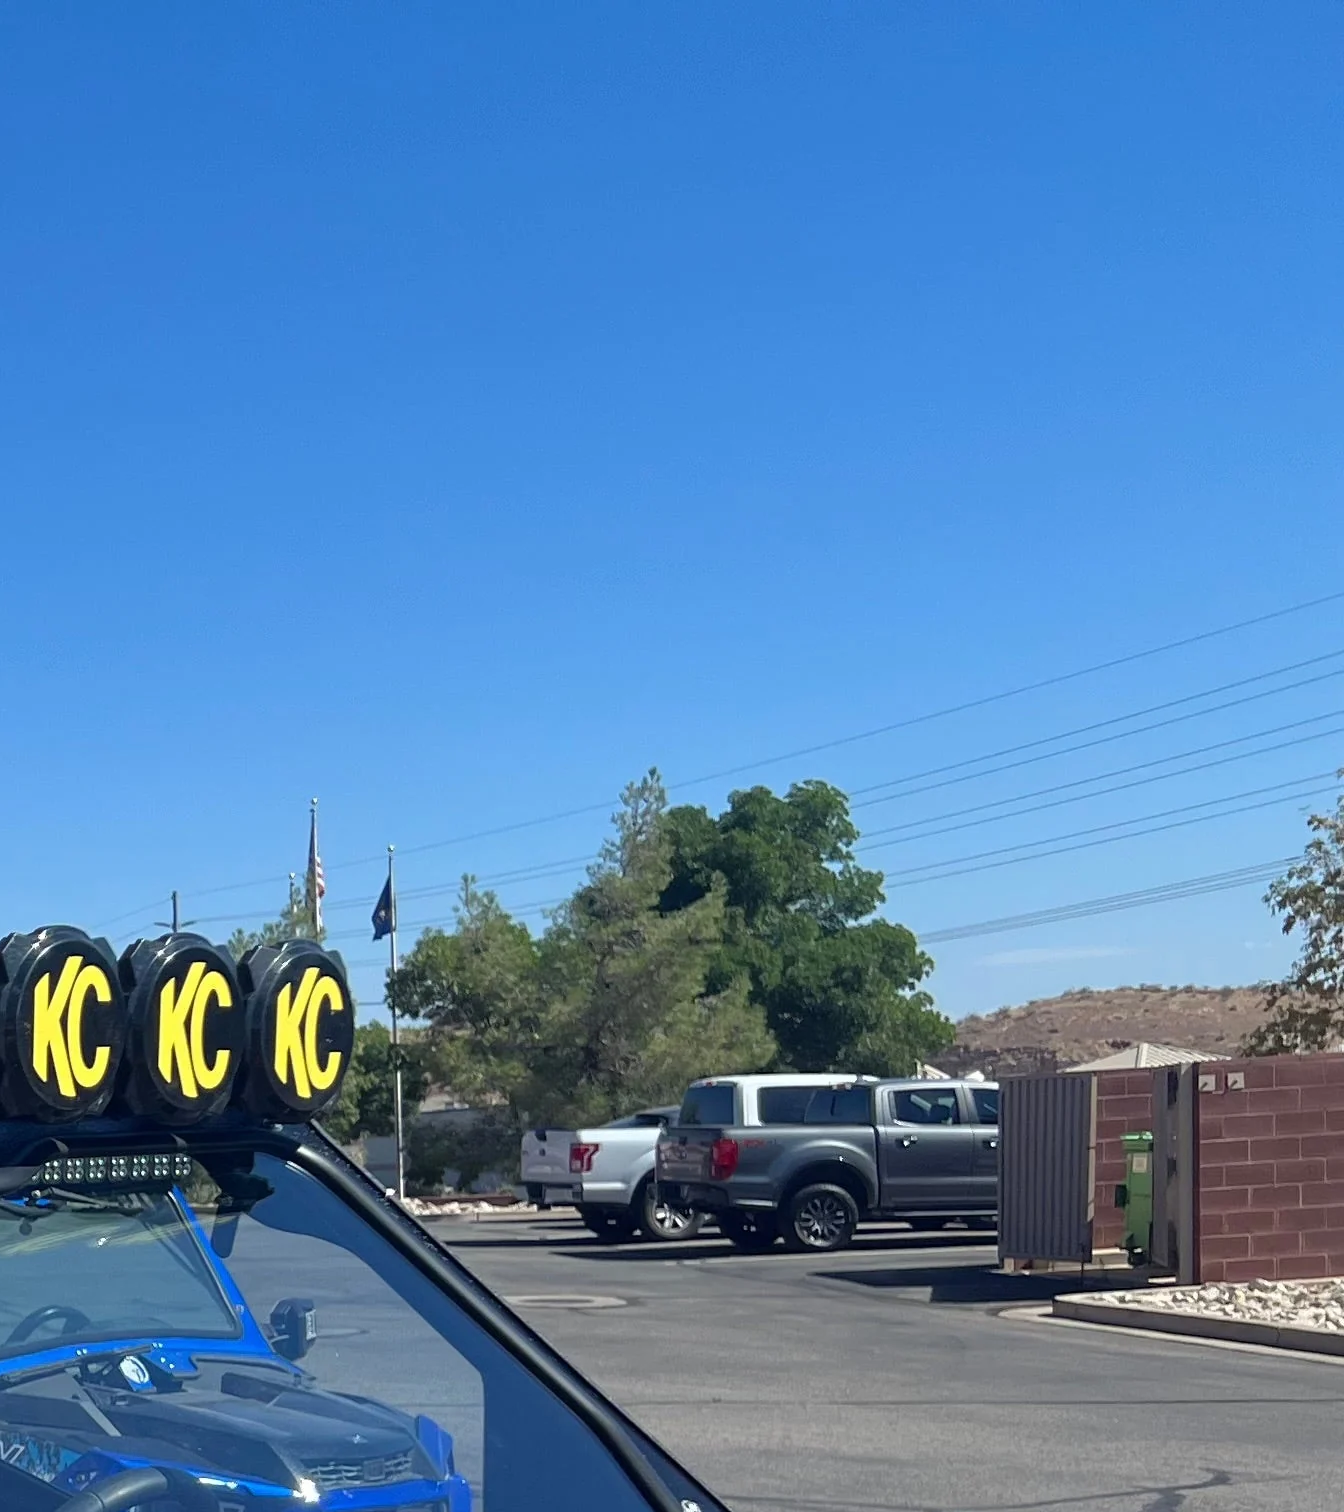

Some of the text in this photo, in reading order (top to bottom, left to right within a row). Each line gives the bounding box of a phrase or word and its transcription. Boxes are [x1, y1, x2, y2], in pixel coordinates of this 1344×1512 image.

[33, 955, 111, 1098] KC
[158, 962, 232, 1098] KC
[274, 968, 344, 1098] KC
